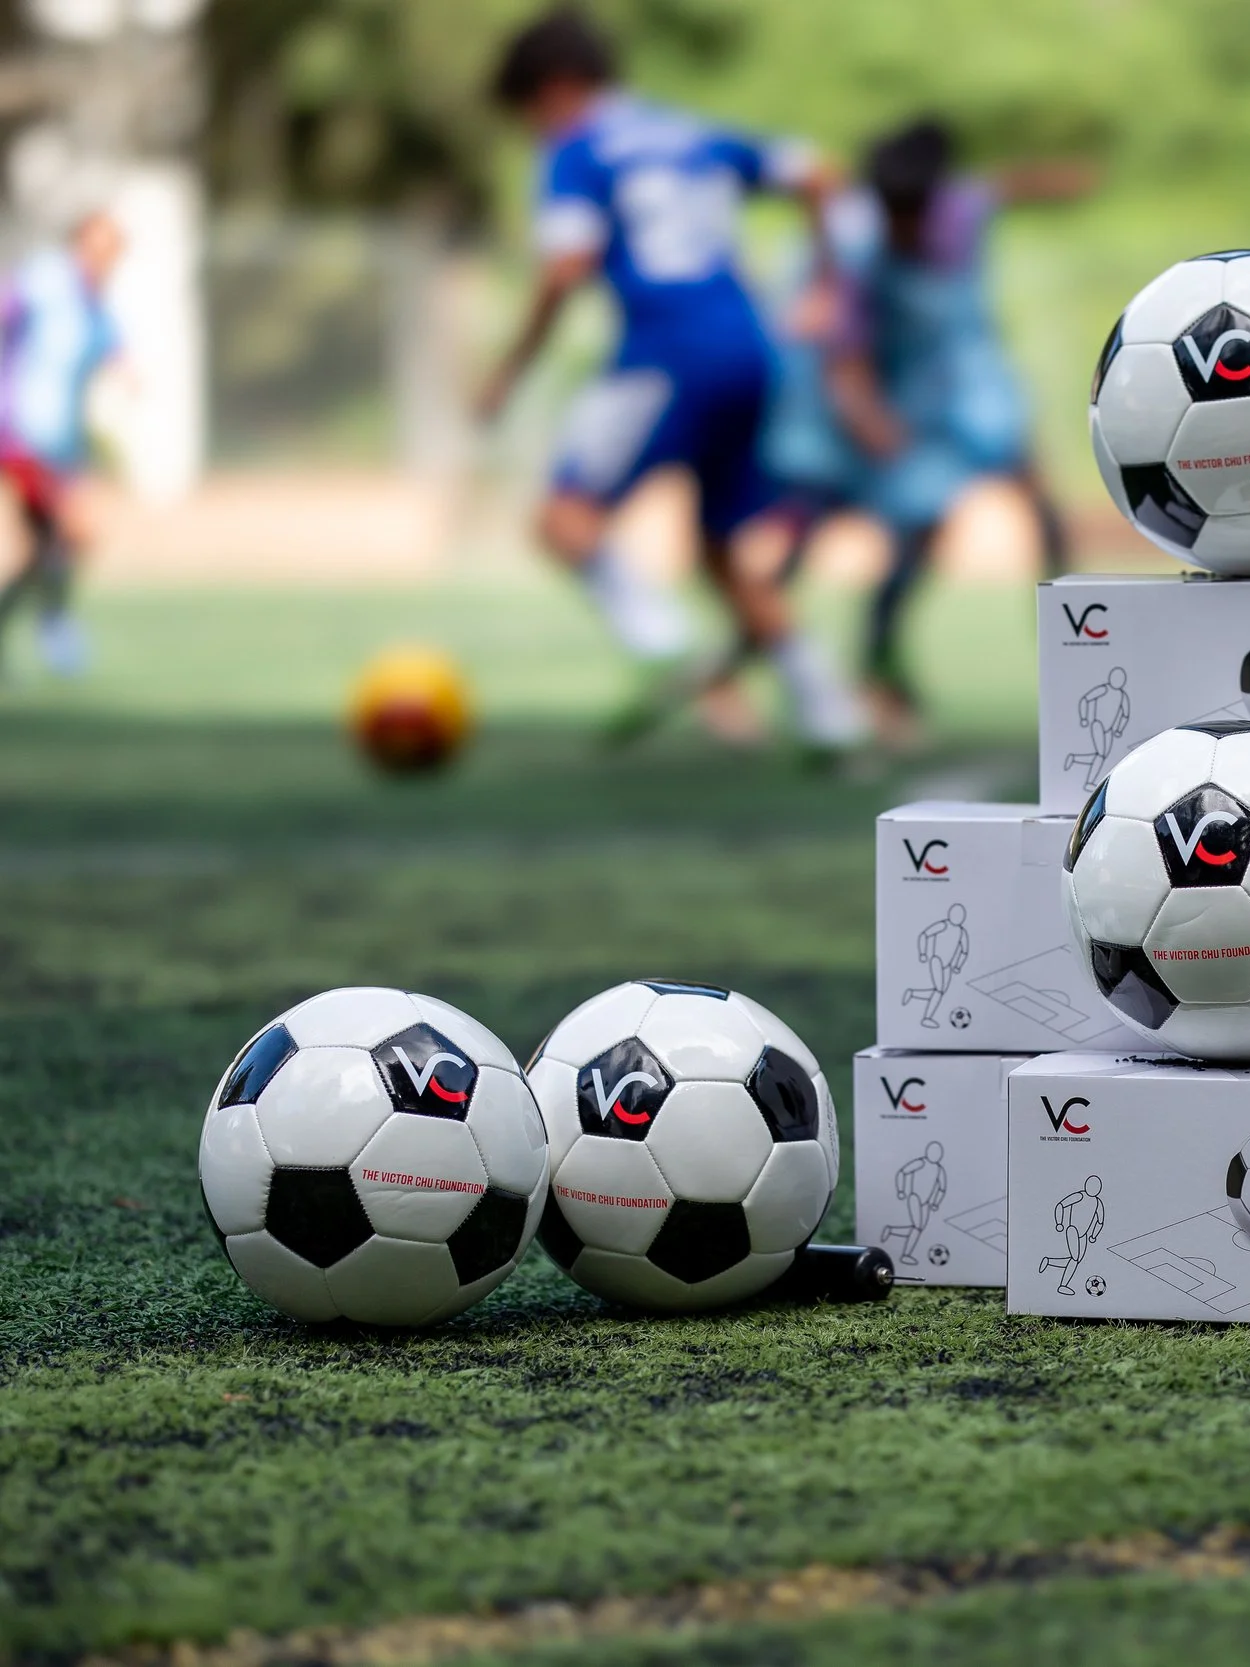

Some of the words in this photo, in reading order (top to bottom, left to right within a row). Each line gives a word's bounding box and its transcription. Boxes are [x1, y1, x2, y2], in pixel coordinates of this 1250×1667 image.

[1177, 459, 1191, 470] THE
[1194, 458, 1223, 469] VICTOR
[1224, 456, 1242, 467] CHU
[1062, 603, 1109, 639] VC
[902, 838, 949, 875] VC
[1164, 810, 1238, 867] VC
[1153, 950, 1168, 960] THE
[1169, 950, 1200, 960] VICTOR
[1201, 948, 1219, 959] CHU
[391, 1046, 469, 1103] VC
[592, 1068, 659, 1125] VC
[880, 1076, 926, 1112] VC
[1040, 1095, 1091, 1135] VC
[362, 1169, 379, 1181] THE
[381, 1172, 413, 1186] VICTOR
[415, 1176, 433, 1188] CHU
[434, 1179, 485, 1195] FOUNDATION
[556, 1185, 569, 1197] THE
[570, 1189, 597, 1203] VICTOR
[598, 1194, 614, 1206] CHU
[616, 1197, 668, 1209] FOUNDATION
